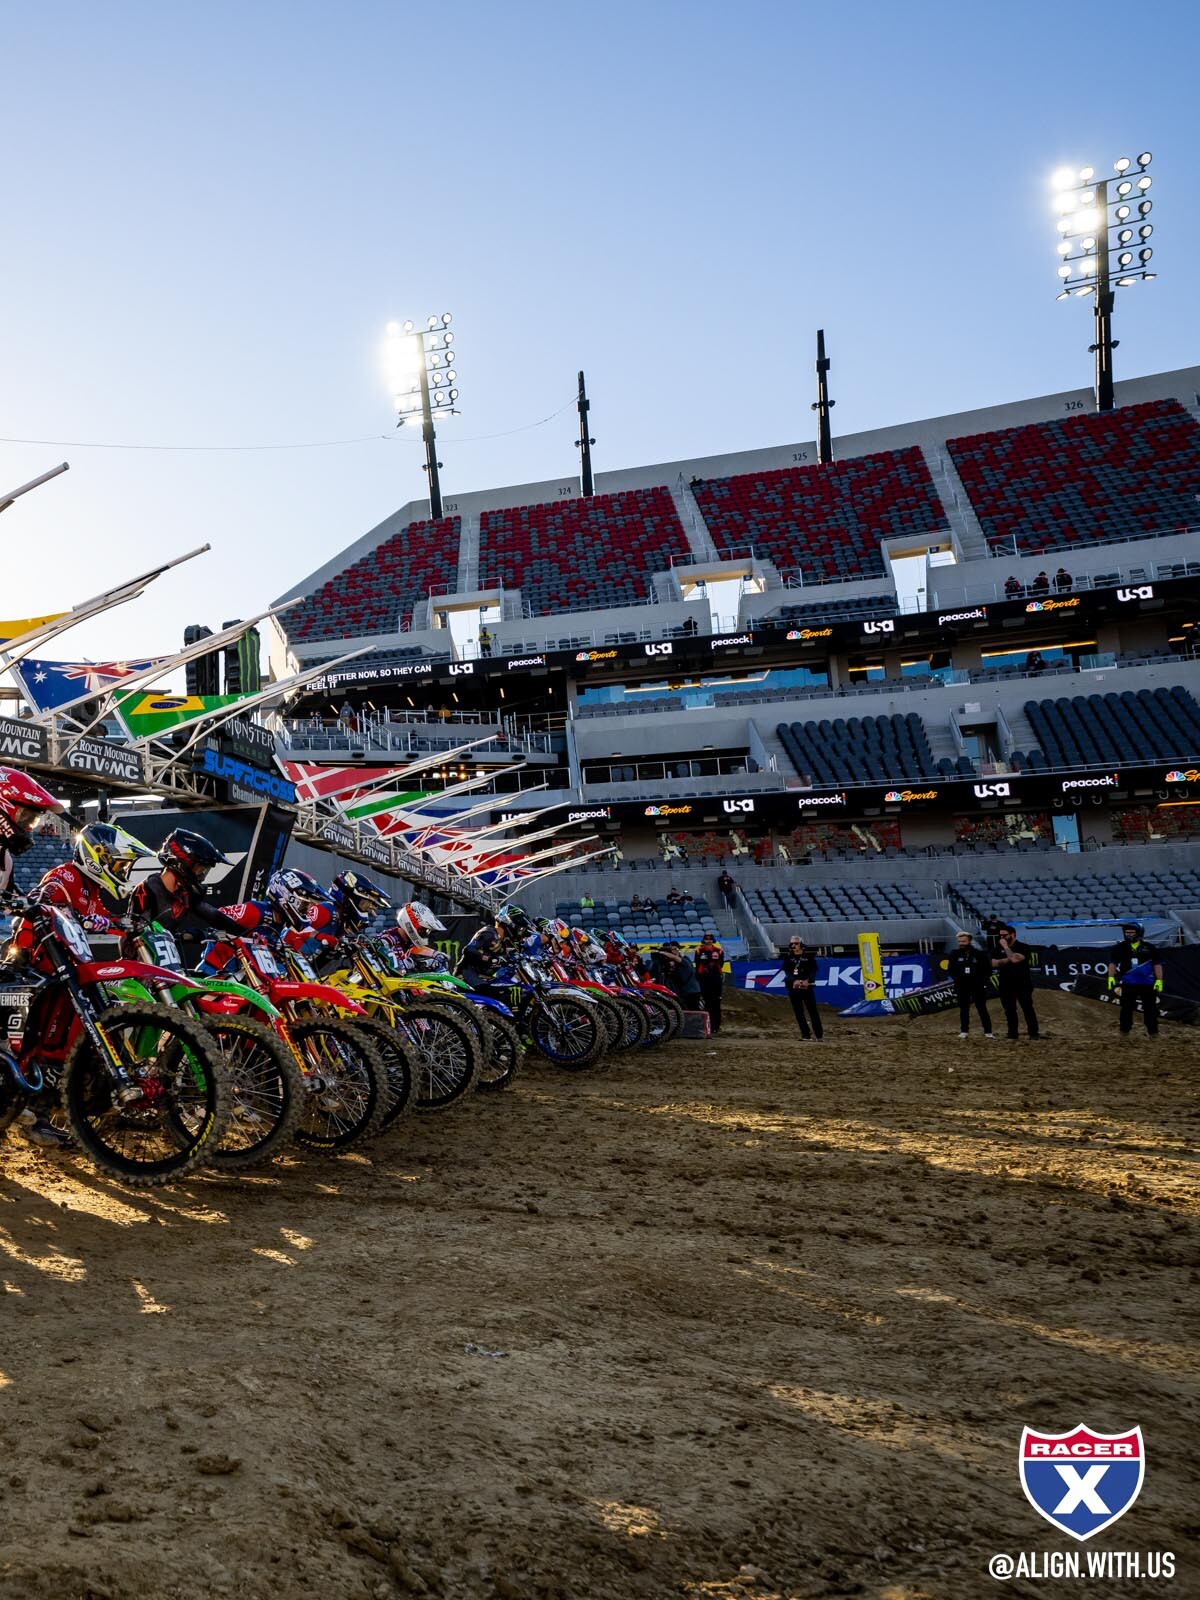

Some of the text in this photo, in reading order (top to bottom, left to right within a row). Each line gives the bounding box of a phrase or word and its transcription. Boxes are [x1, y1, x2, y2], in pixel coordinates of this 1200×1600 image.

[1064, 400, 1084, 411] 326
[792, 452, 808, 462] 325
[558, 487, 571, 495] 324
[1042, 598, 1080, 612] Sports
[938, 608, 983, 626] peacock
[800, 628, 833, 640] Sports
[711, 635, 749, 649] peacock
[588, 650, 618, 661] Sports
[508, 657, 543, 670] peacock
[327, 671, 357, 683] BETTER
[358, 669, 379, 682] NOW,
[380, 668, 392, 678] SO
[392, 666, 413, 676] THEY
[414, 664, 432, 674] CAN
[306, 681, 337, 691] FEEL IT
[225, 719, 275, 751] MONSTER
[79, 739, 138, 765] ROCKY MOUNTAIN
[203, 749, 296, 803] SUPERCROSS
[1062, 776, 1114, 792] peacock
[798, 794, 841, 809] peacock
[899, 789, 938, 802] Sports
[568, 809, 608, 823] peacock
[659, 803, 692, 817] Sports
[156, 941, 182, 966] 50
[744, 963, 924, 989] FAKEN
